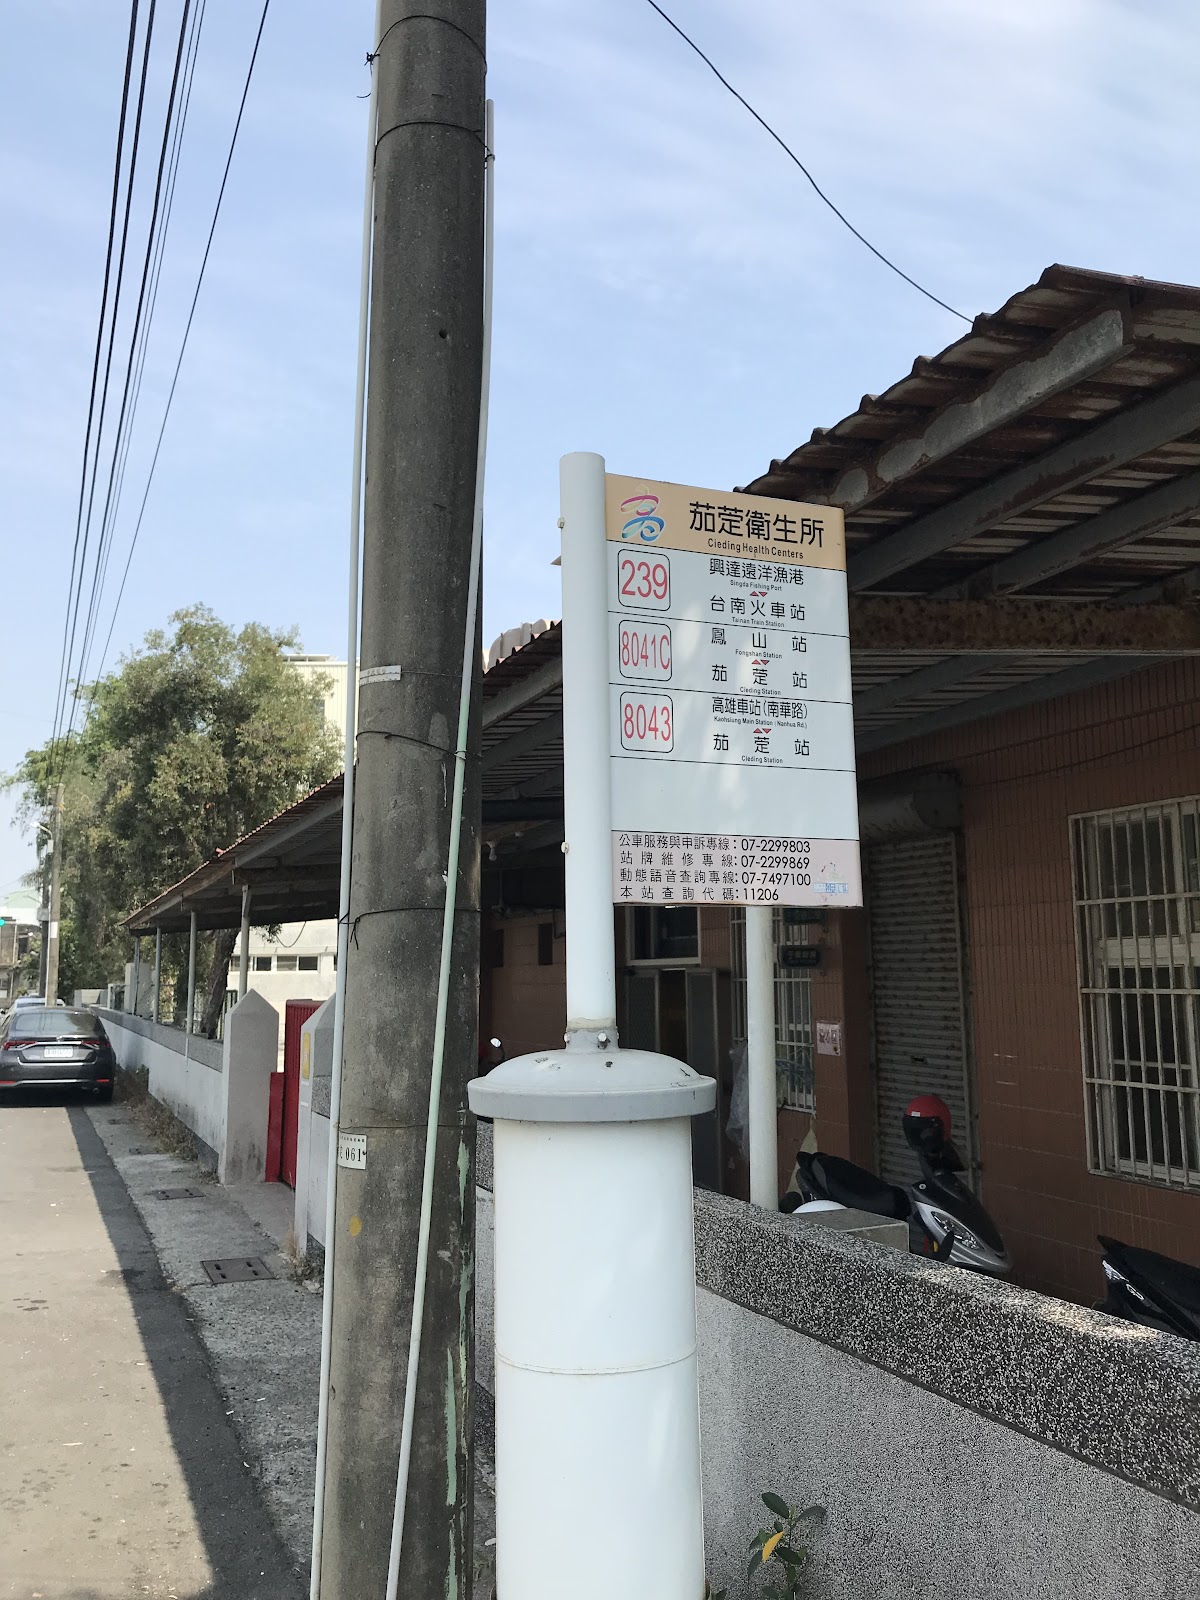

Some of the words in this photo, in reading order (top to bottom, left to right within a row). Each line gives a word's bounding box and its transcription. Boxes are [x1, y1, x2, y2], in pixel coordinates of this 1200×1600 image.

[689, 501, 824, 548] 茄萣衛生所
[707, 537, 741, 554] Cieding
[742, 540, 770, 555] Health
[771, 546, 804, 559] Centers
[709, 557, 804, 586] 興達遠洋漁港
[621, 559, 668, 600] 239
[729, 579, 749, 588] Singda
[750, 582, 770, 591] Fishing
[771, 584, 783, 592] Port
[710, 594, 806, 621] 台南火車站
[731, 616, 750, 625] Tainan
[750, 618, 765, 626] Train
[765, 620, 785, 628] Station
[621, 630, 671, 670] 8041C
[735, 648, 763, 658] Fongshan
[762, 651, 783, 659] Station
[739, 686, 761, 696] Cieding
[761, 688, 782, 696] Station
[623, 703, 671, 742] 8043
[714, 715, 742, 725] Kaohsiung
[742, 717, 755, 725] Main
[755, 718, 774, 726] Station
[741, 755, 763, 764] Cieding
[740, 838, 811, 853] 07-2299803
[740, 855, 810, 870] 07-2299869
[741, 872, 811, 886] 07-7497100
[742, 888, 779, 901] 11206
